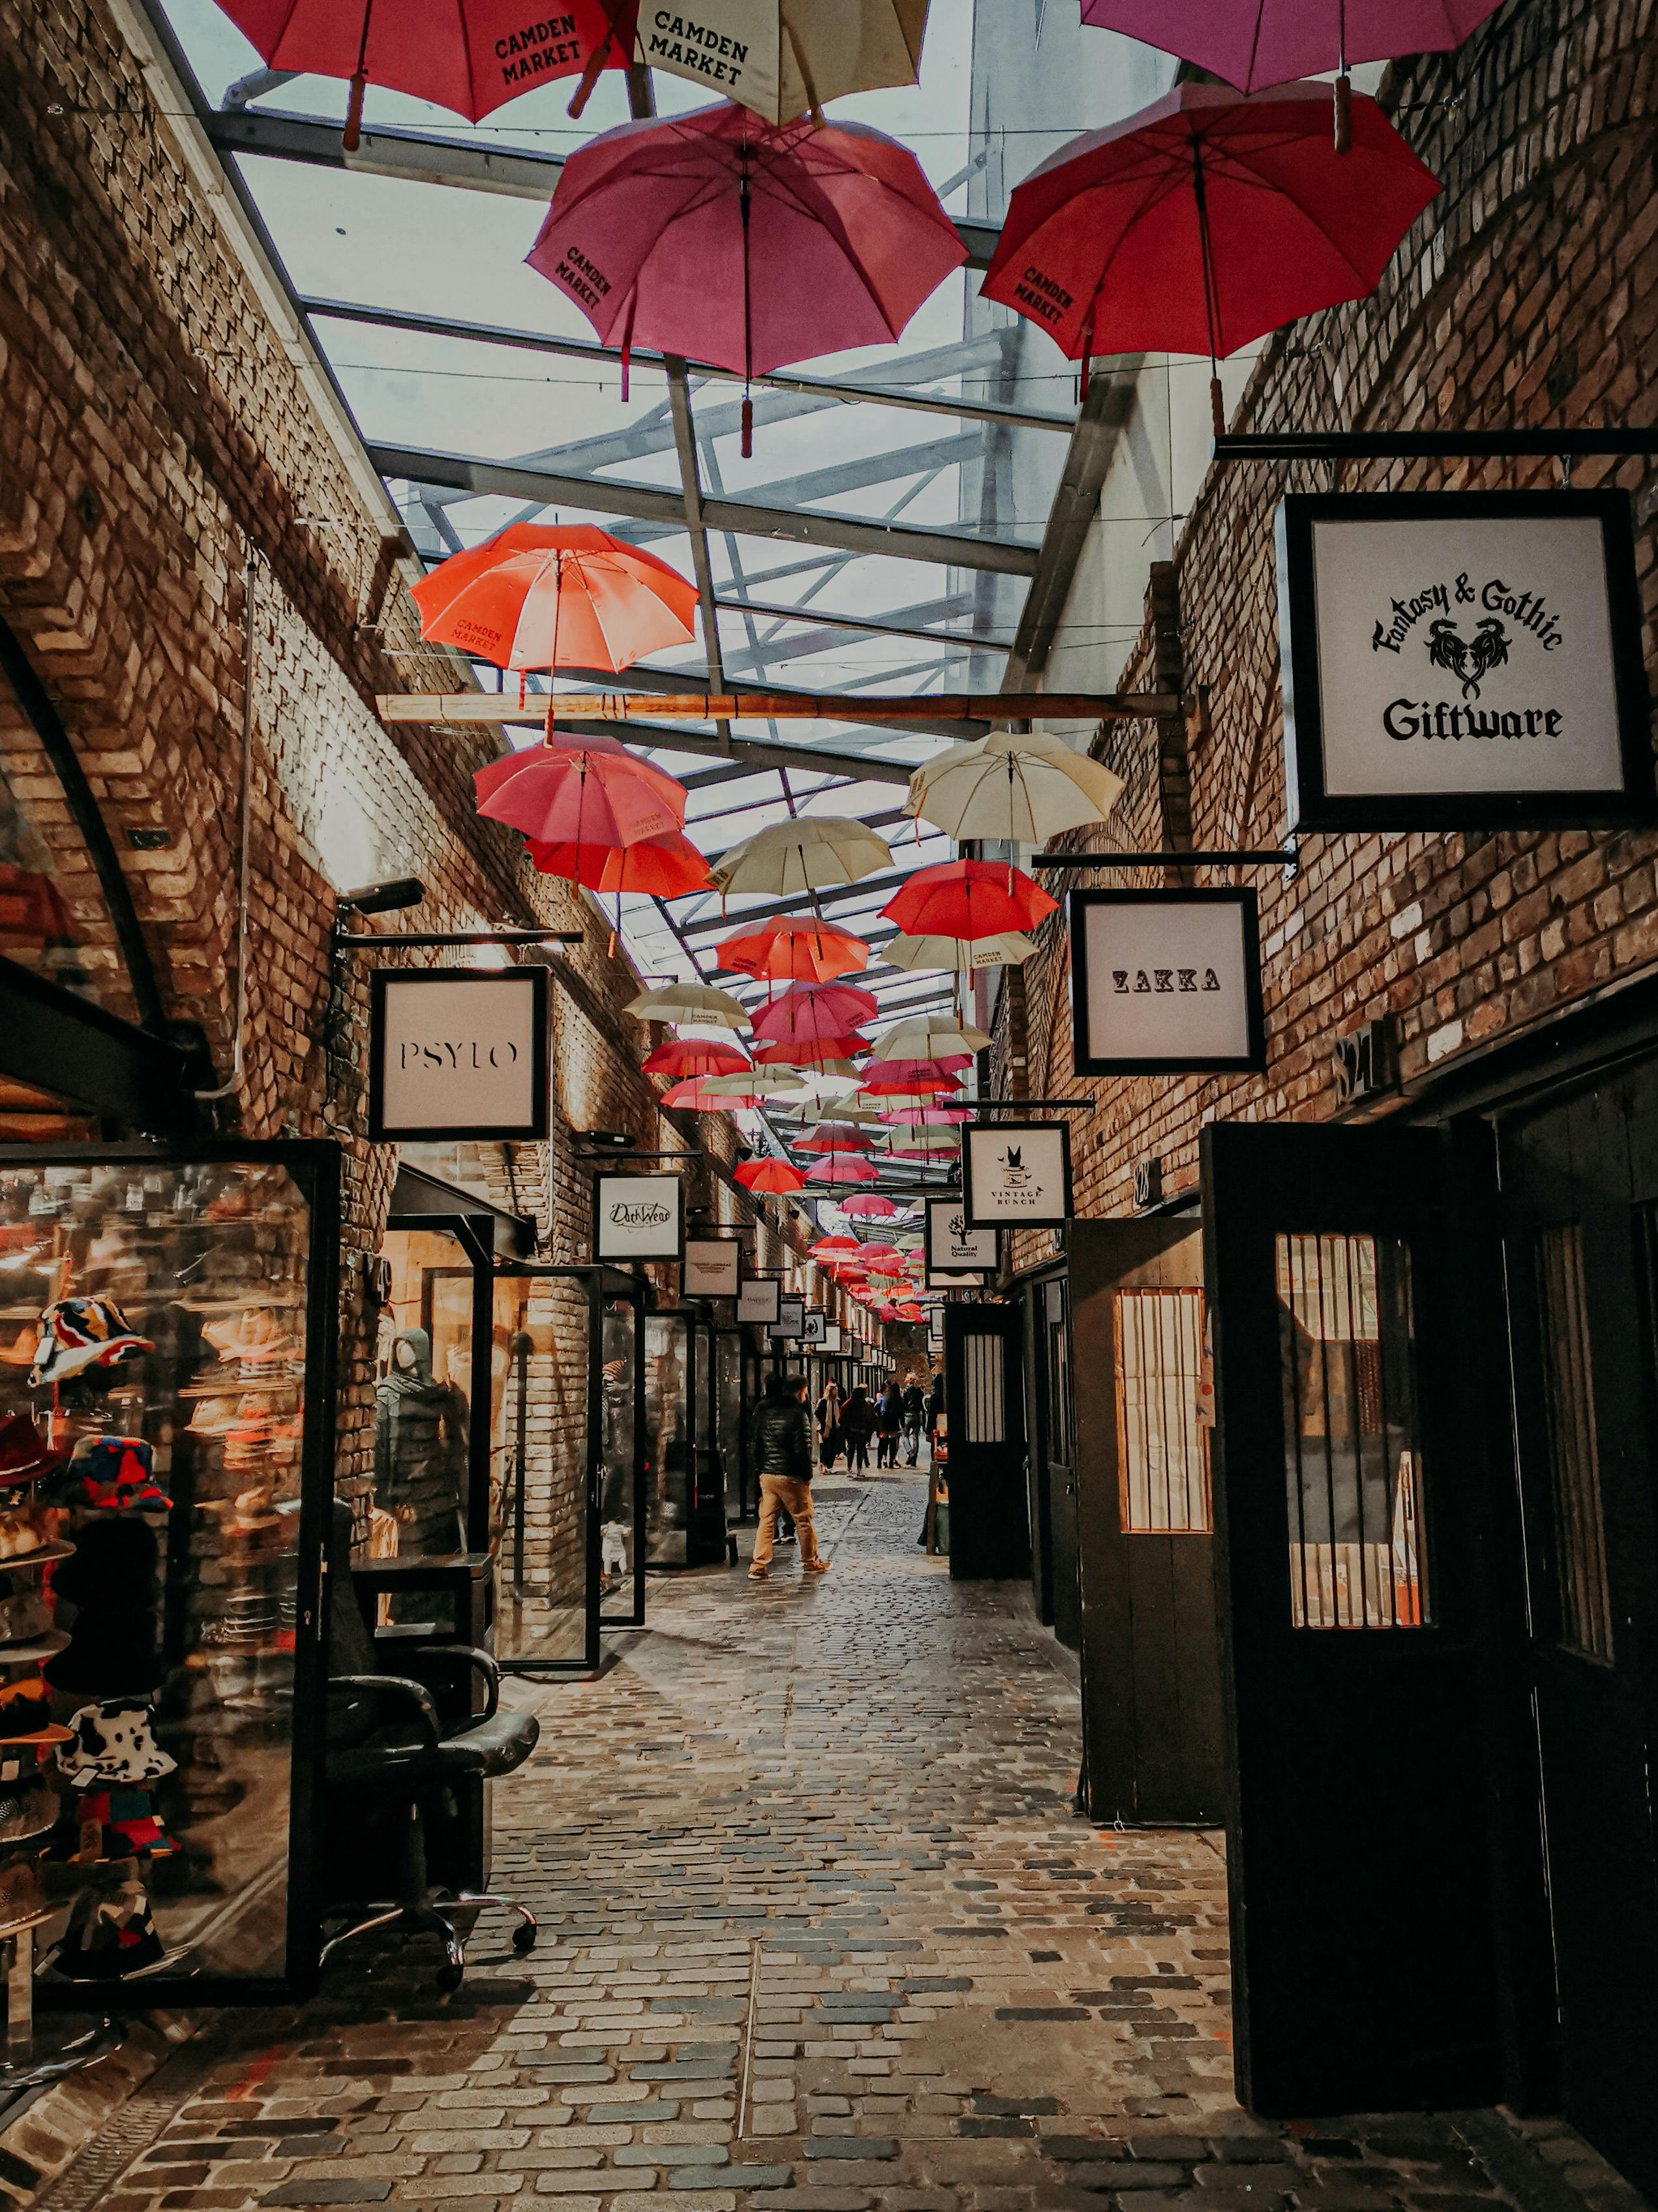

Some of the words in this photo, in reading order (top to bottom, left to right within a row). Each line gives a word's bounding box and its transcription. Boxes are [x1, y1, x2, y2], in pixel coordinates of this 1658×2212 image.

[495, 14, 577, 59] CAMDEN
[655, 10, 749, 64] CAMDEN
[501, 40, 580, 85] MARKET
[651, 34, 743, 86] MARKET
[555, 261, 600, 310] MARKET
[567, 247, 612, 296] CAMDEN
[1024, 266, 1073, 309] CAMDEN
[1013, 283, 1063, 325] MARKET
[457, 619, 502, 641] CAMDEN
[1372, 583, 1451, 655] Fantasy
[1455, 571, 1476, 605] &
[1481, 579, 1563, 651] Gothic
[451, 629, 496, 651] MARKET
[1383, 698, 1563, 741] Giftware
[1112, 968, 1221, 993] ZAKKA
[401, 1042, 517, 1069] PSYLO
